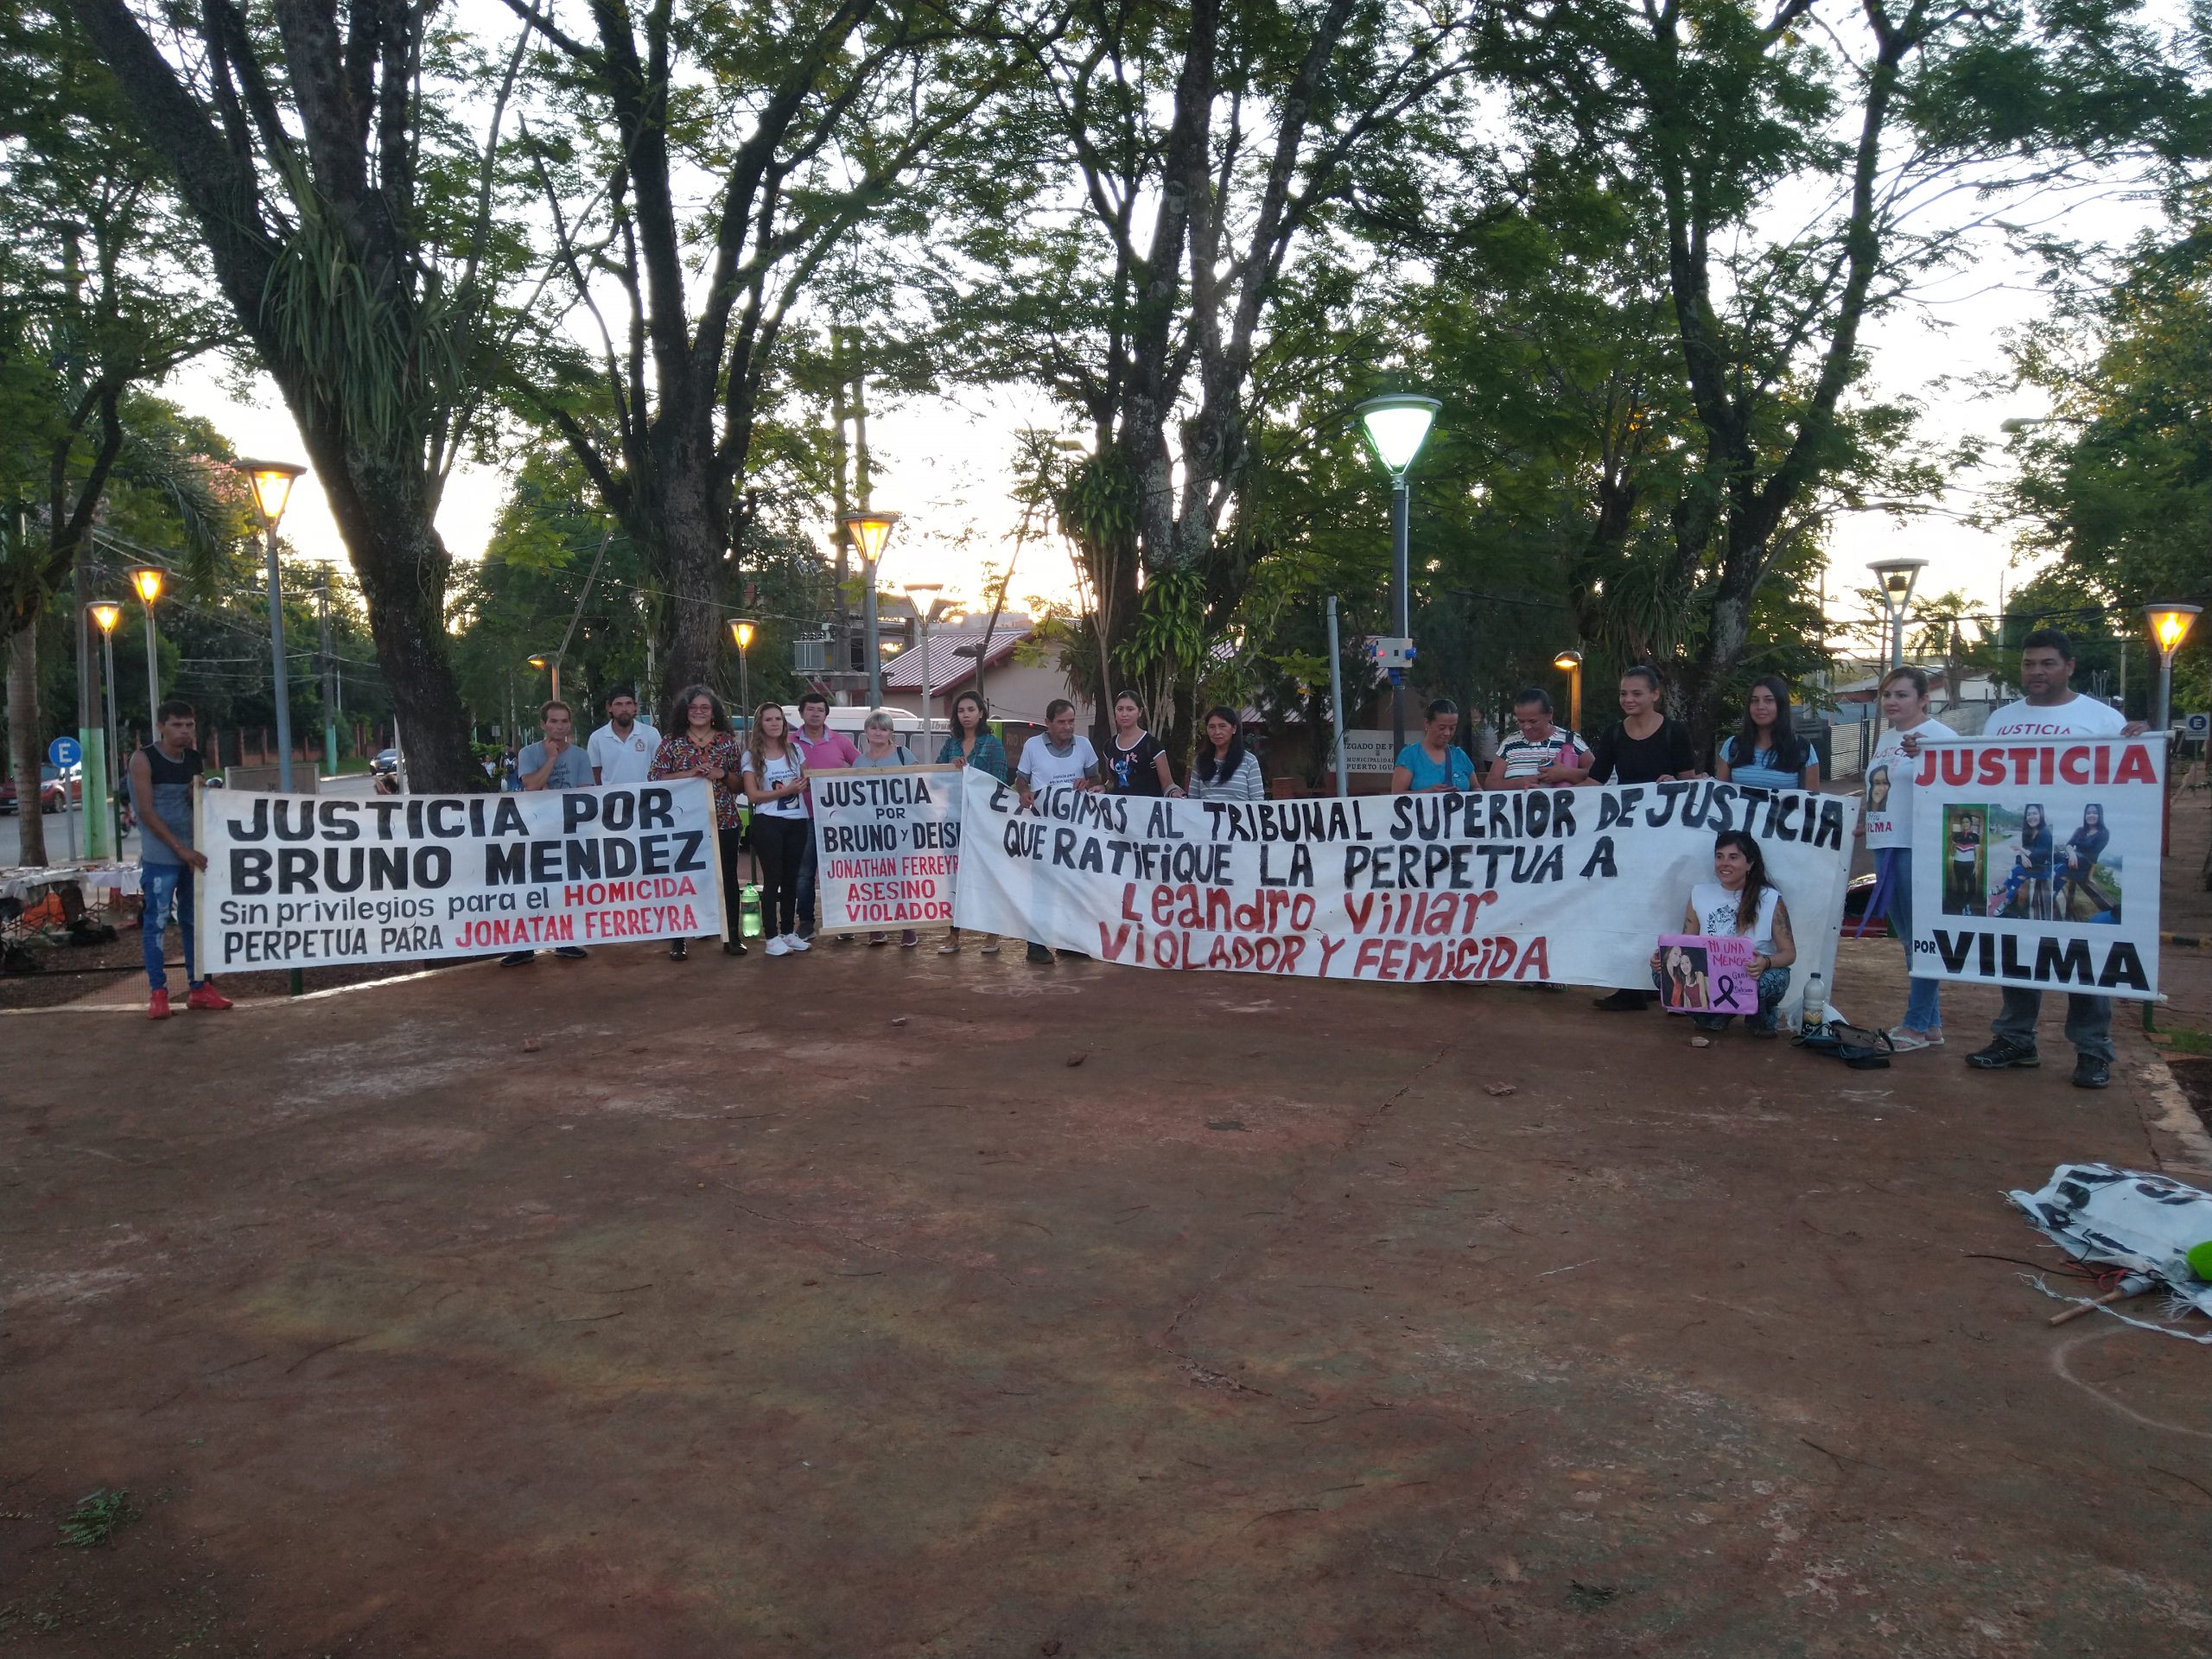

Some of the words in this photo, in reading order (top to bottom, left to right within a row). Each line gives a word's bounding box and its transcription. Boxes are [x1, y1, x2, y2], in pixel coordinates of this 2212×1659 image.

[1996, 723, 2071, 735] JUSTICIA
[58, 743, 73, 763] E
[1915, 745, 2158, 786] JUSTICIA
[821, 778, 931, 808] JUSTICIA
[875, 807, 906, 820] POR
[227, 798, 530, 842] JUSTICIA
[563, 788, 675, 835] POR
[1147, 801, 1185, 839] AL
[1203, 800, 1372, 842] TRIBUNAL
[1390, 789, 1577, 842] SUPERIOR
[1593, 787, 1643, 832] DE
[823, 823, 898, 854] BRUNO
[1003, 819, 1047, 861] QUE
[1260, 842, 1314, 887] LA
[1344, 843, 1564, 890] PERPETUA
[1580, 836, 1618, 879] A
[230, 846, 452, 895] BRUNO
[486, 830, 707, 887] MENDEZ
[827, 857, 897, 879] JONATHAN
[220, 900, 268, 925] Sin
[276, 897, 435, 929] privilegios
[448, 891, 516, 921] para
[526, 887, 550, 910] el
[564, 875, 697, 907] HOMICIDA
[848, 879, 936, 902] ASESINO
[1122, 882, 1316, 936] Leandro
[1344, 889, 1498, 936] Villar
[845, 901, 954, 922] VIOLADOR
[224, 927, 367, 965] PERPETUA
[381, 924, 444, 955] PARA
[455, 913, 574, 948] JONATAN
[585, 904, 698, 939] FERREYRA
[1319, 932, 1346, 977] Y
[1708, 940, 1719, 953] NI
[1724, 942, 1745, 954] UNA
[1914, 939, 1936, 954] POR
[1932, 929, 2151, 992] VILMA
